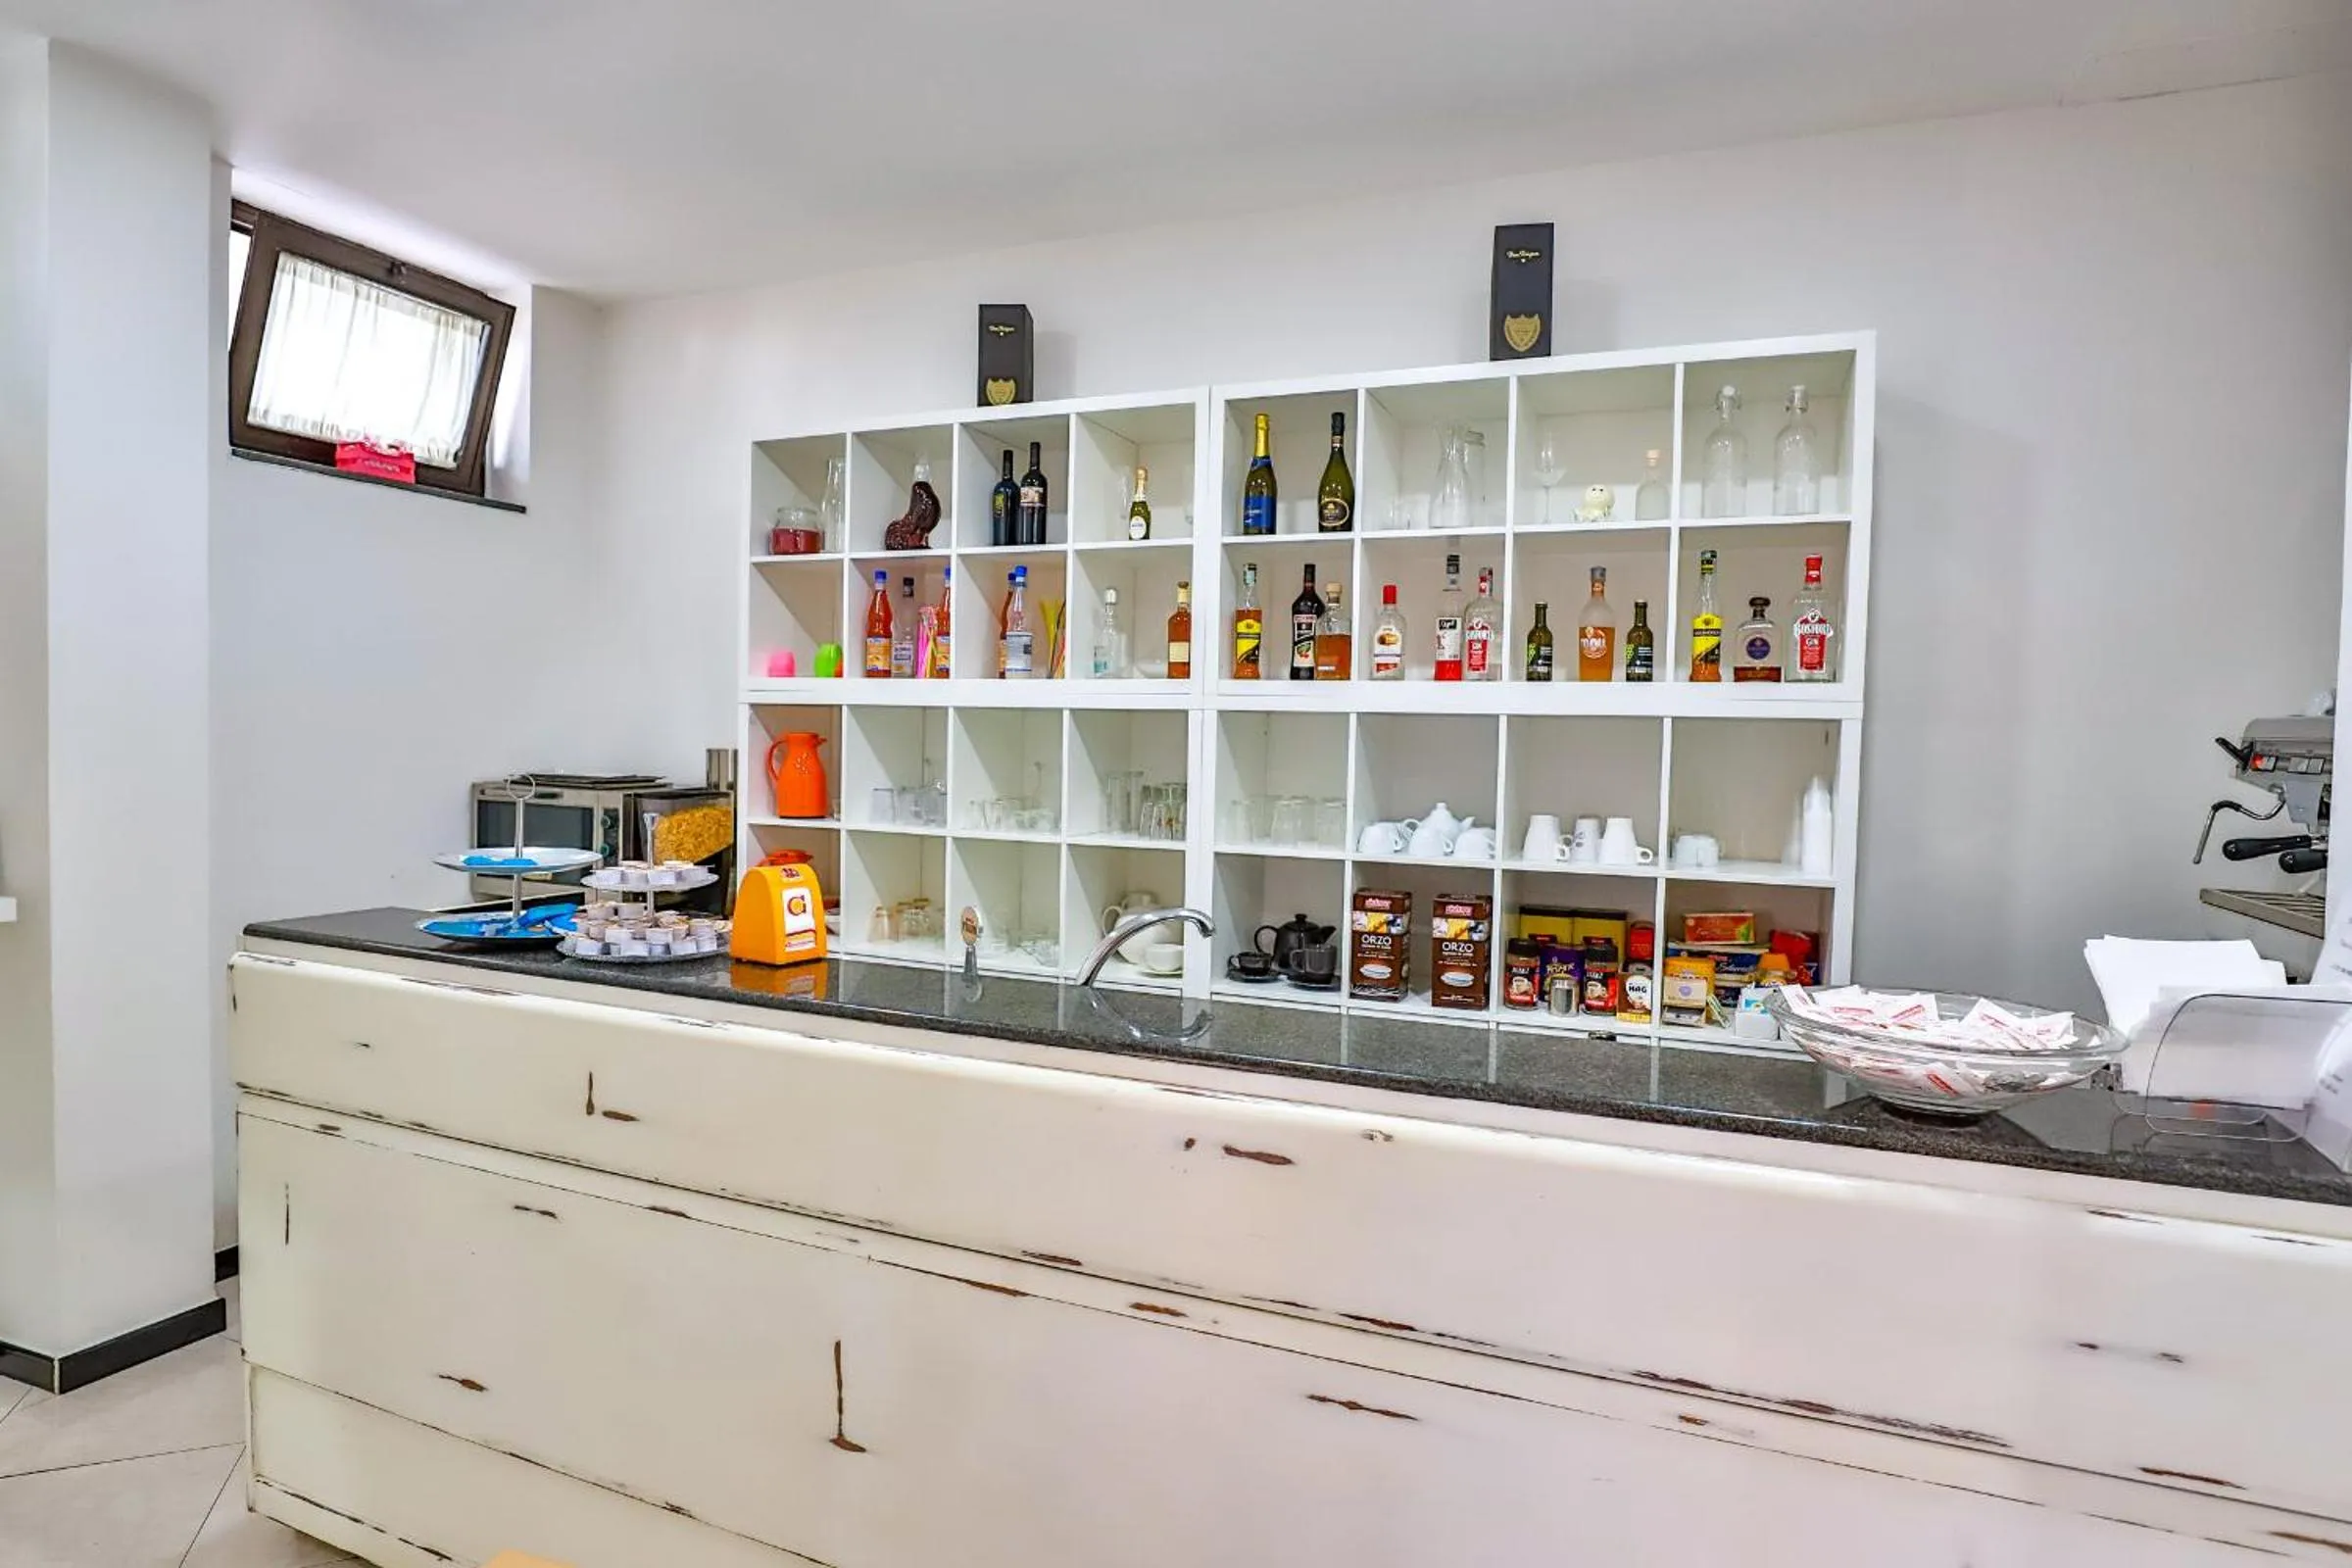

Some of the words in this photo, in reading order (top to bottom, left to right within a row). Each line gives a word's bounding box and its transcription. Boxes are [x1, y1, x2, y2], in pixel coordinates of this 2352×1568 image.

[1361, 934, 1392, 946] ORZO
[1442, 942, 1474, 953] ORZO
[1629, 985, 1647, 994] HAG
